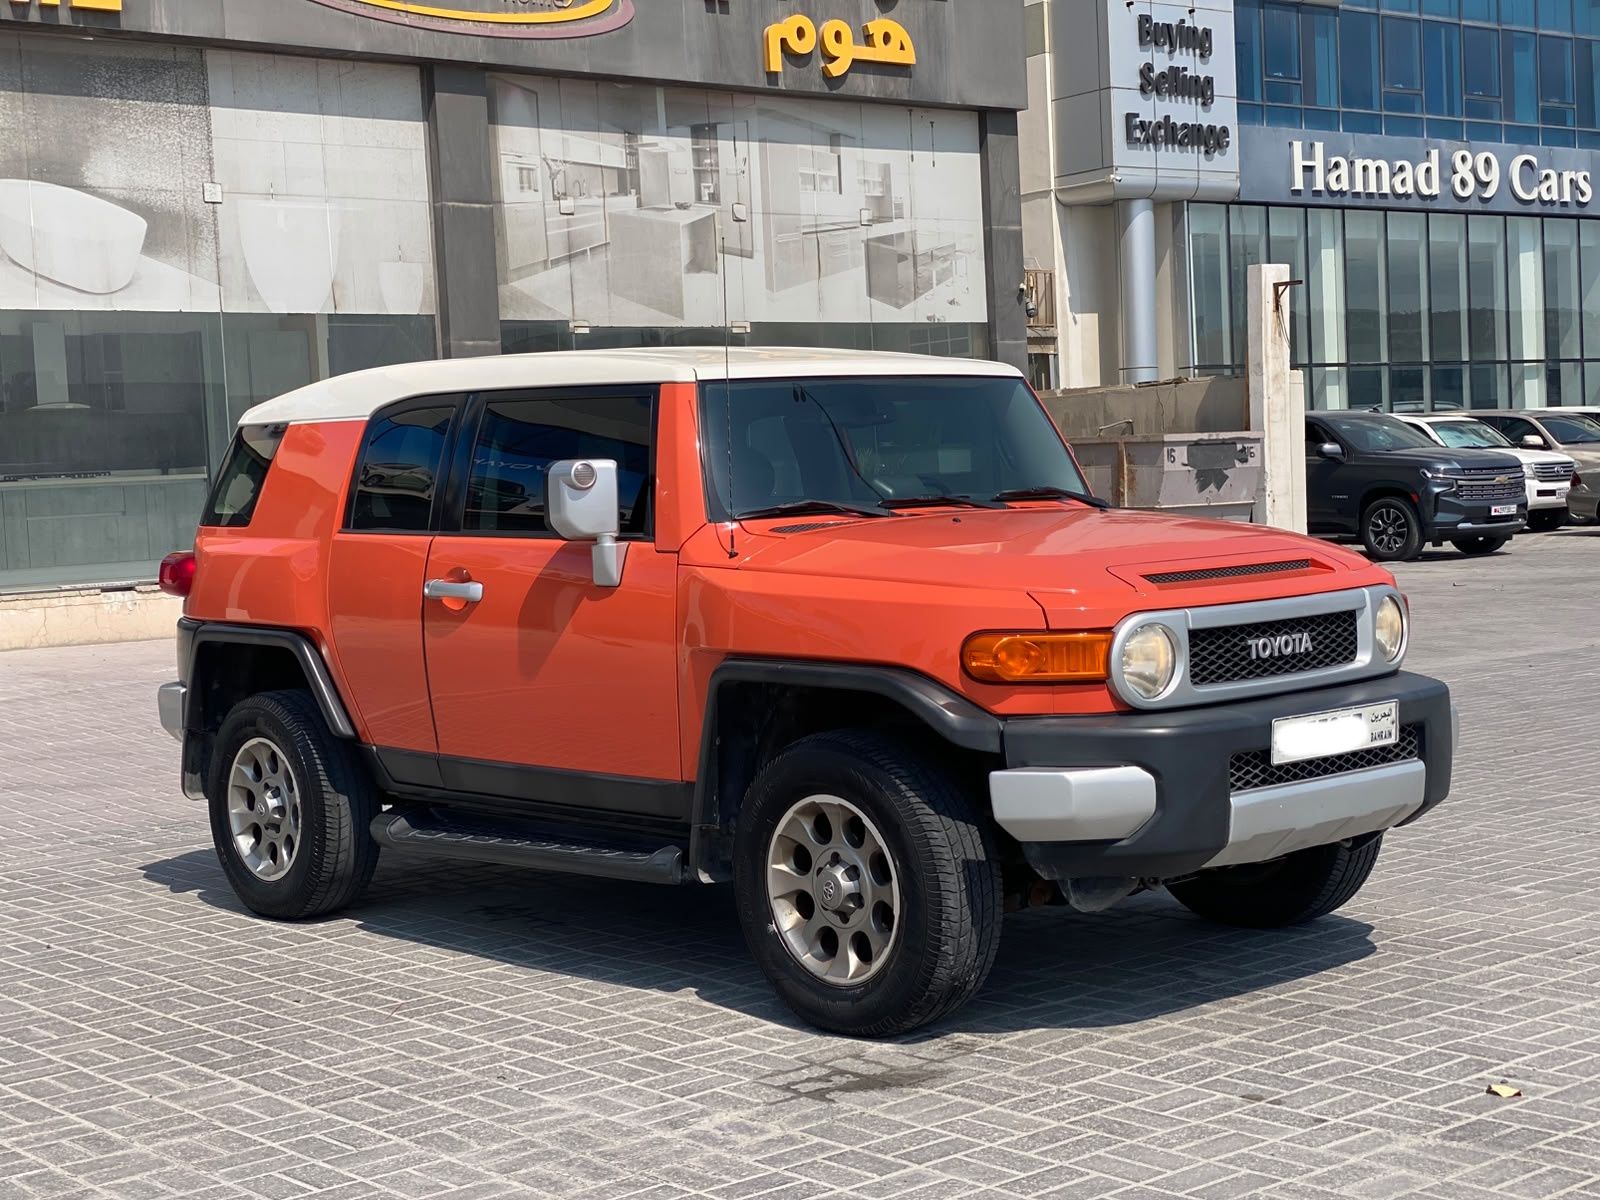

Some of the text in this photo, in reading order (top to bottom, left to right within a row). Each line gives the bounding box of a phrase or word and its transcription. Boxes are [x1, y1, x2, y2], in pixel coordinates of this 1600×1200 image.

[764, 14, 916, 77] هوم
[1138, 14, 1213, 58] Buying
[1139, 62, 1214, 106] Selling
[1125, 112, 1230, 155] Exchange
[1289, 140, 1593, 203] Hamad 89 Cars
[1247, 632, 1313, 660] TOYOTA
[1370, 729, 1393, 743] BAHRAIN
